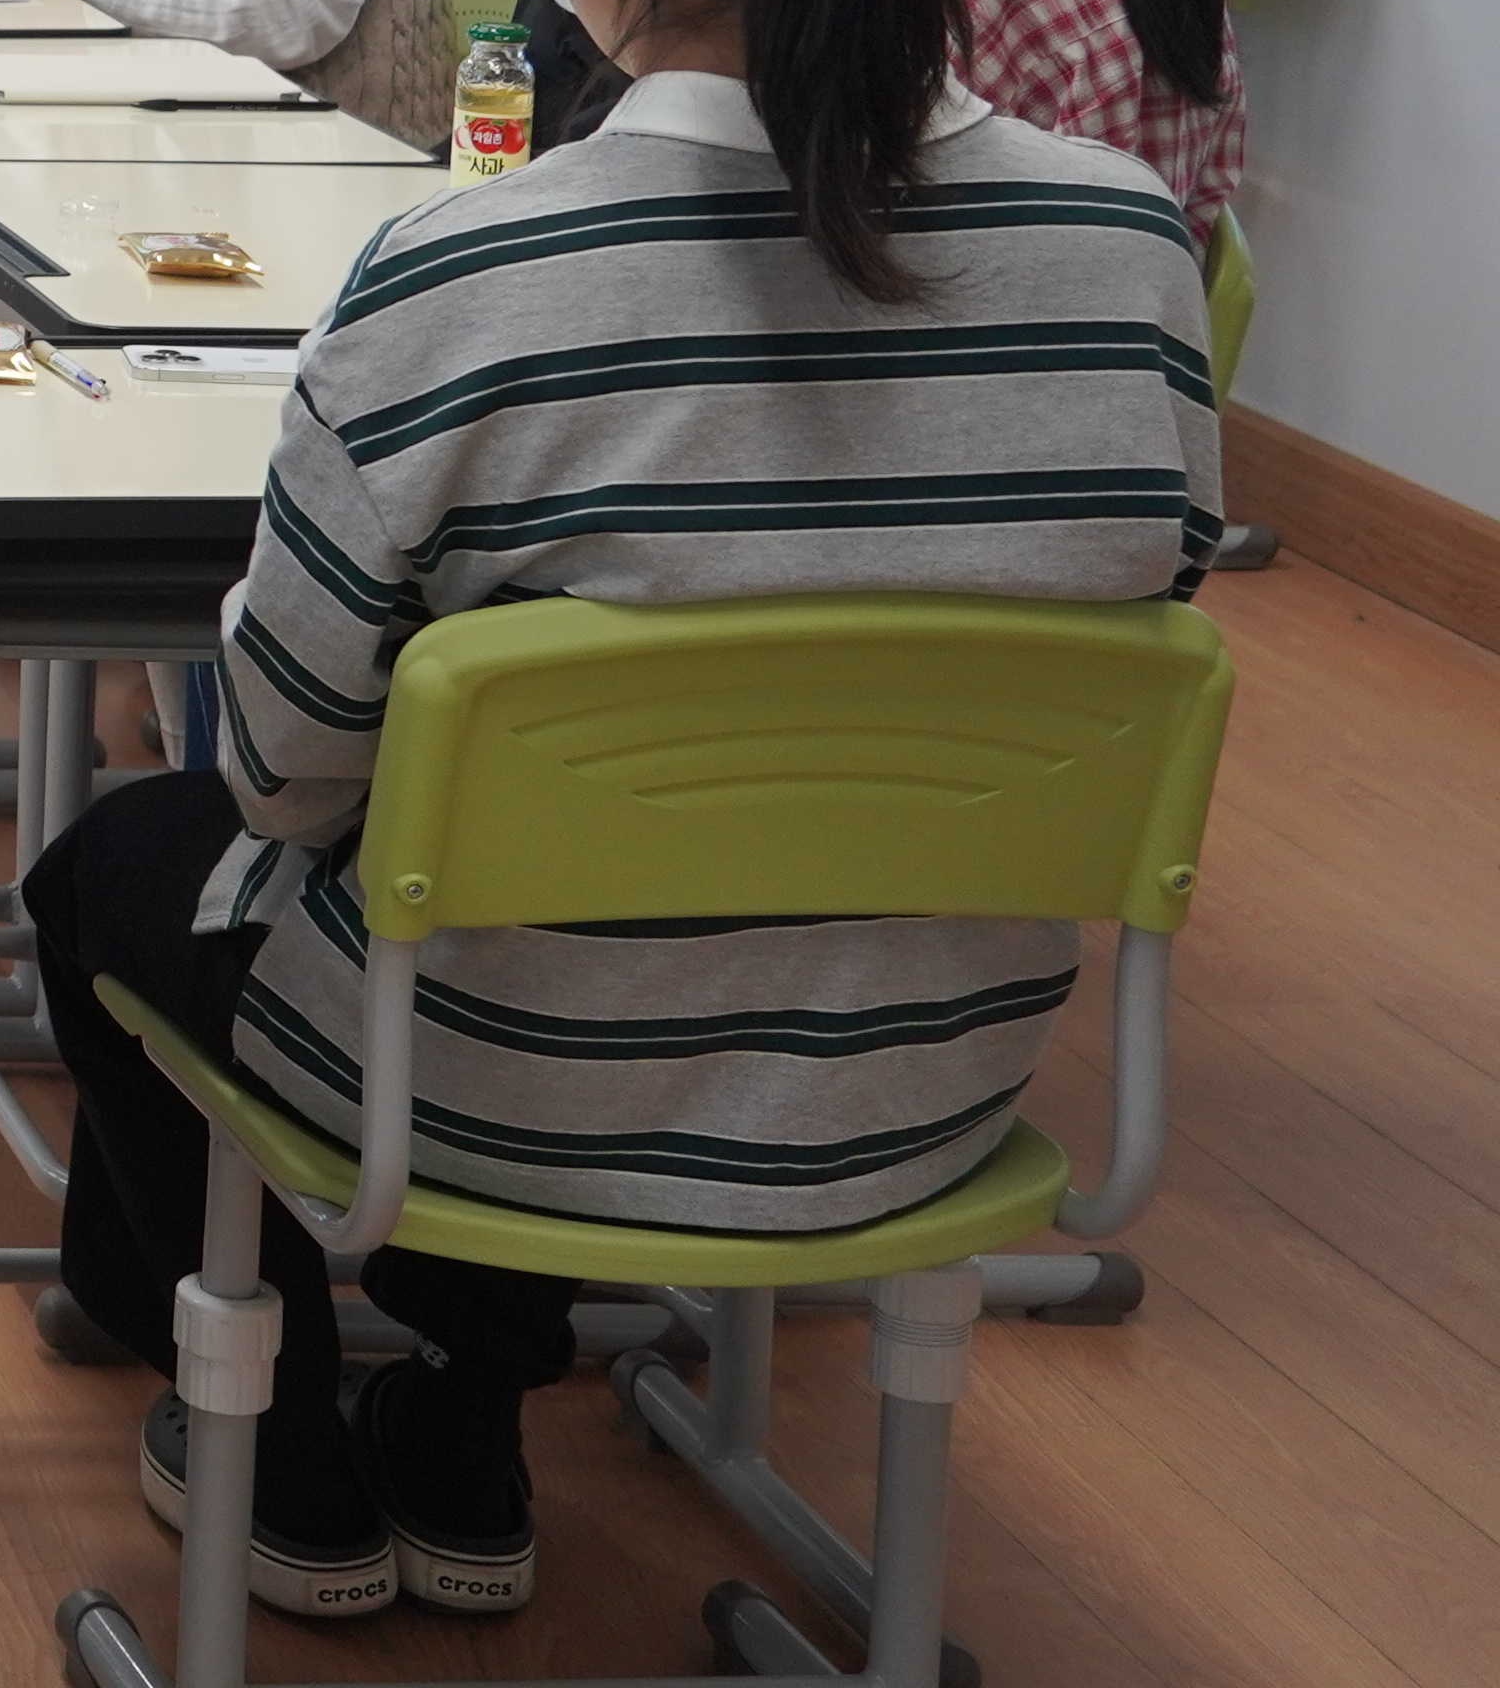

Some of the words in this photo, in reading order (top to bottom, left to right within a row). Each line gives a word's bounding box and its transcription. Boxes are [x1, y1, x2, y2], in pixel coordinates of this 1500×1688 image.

[472, 131, 503, 146] 과일촌
[470, 156, 505, 176] 사과
[317, 1577, 389, 1604] crocs
[437, 1574, 513, 1598] crocs
